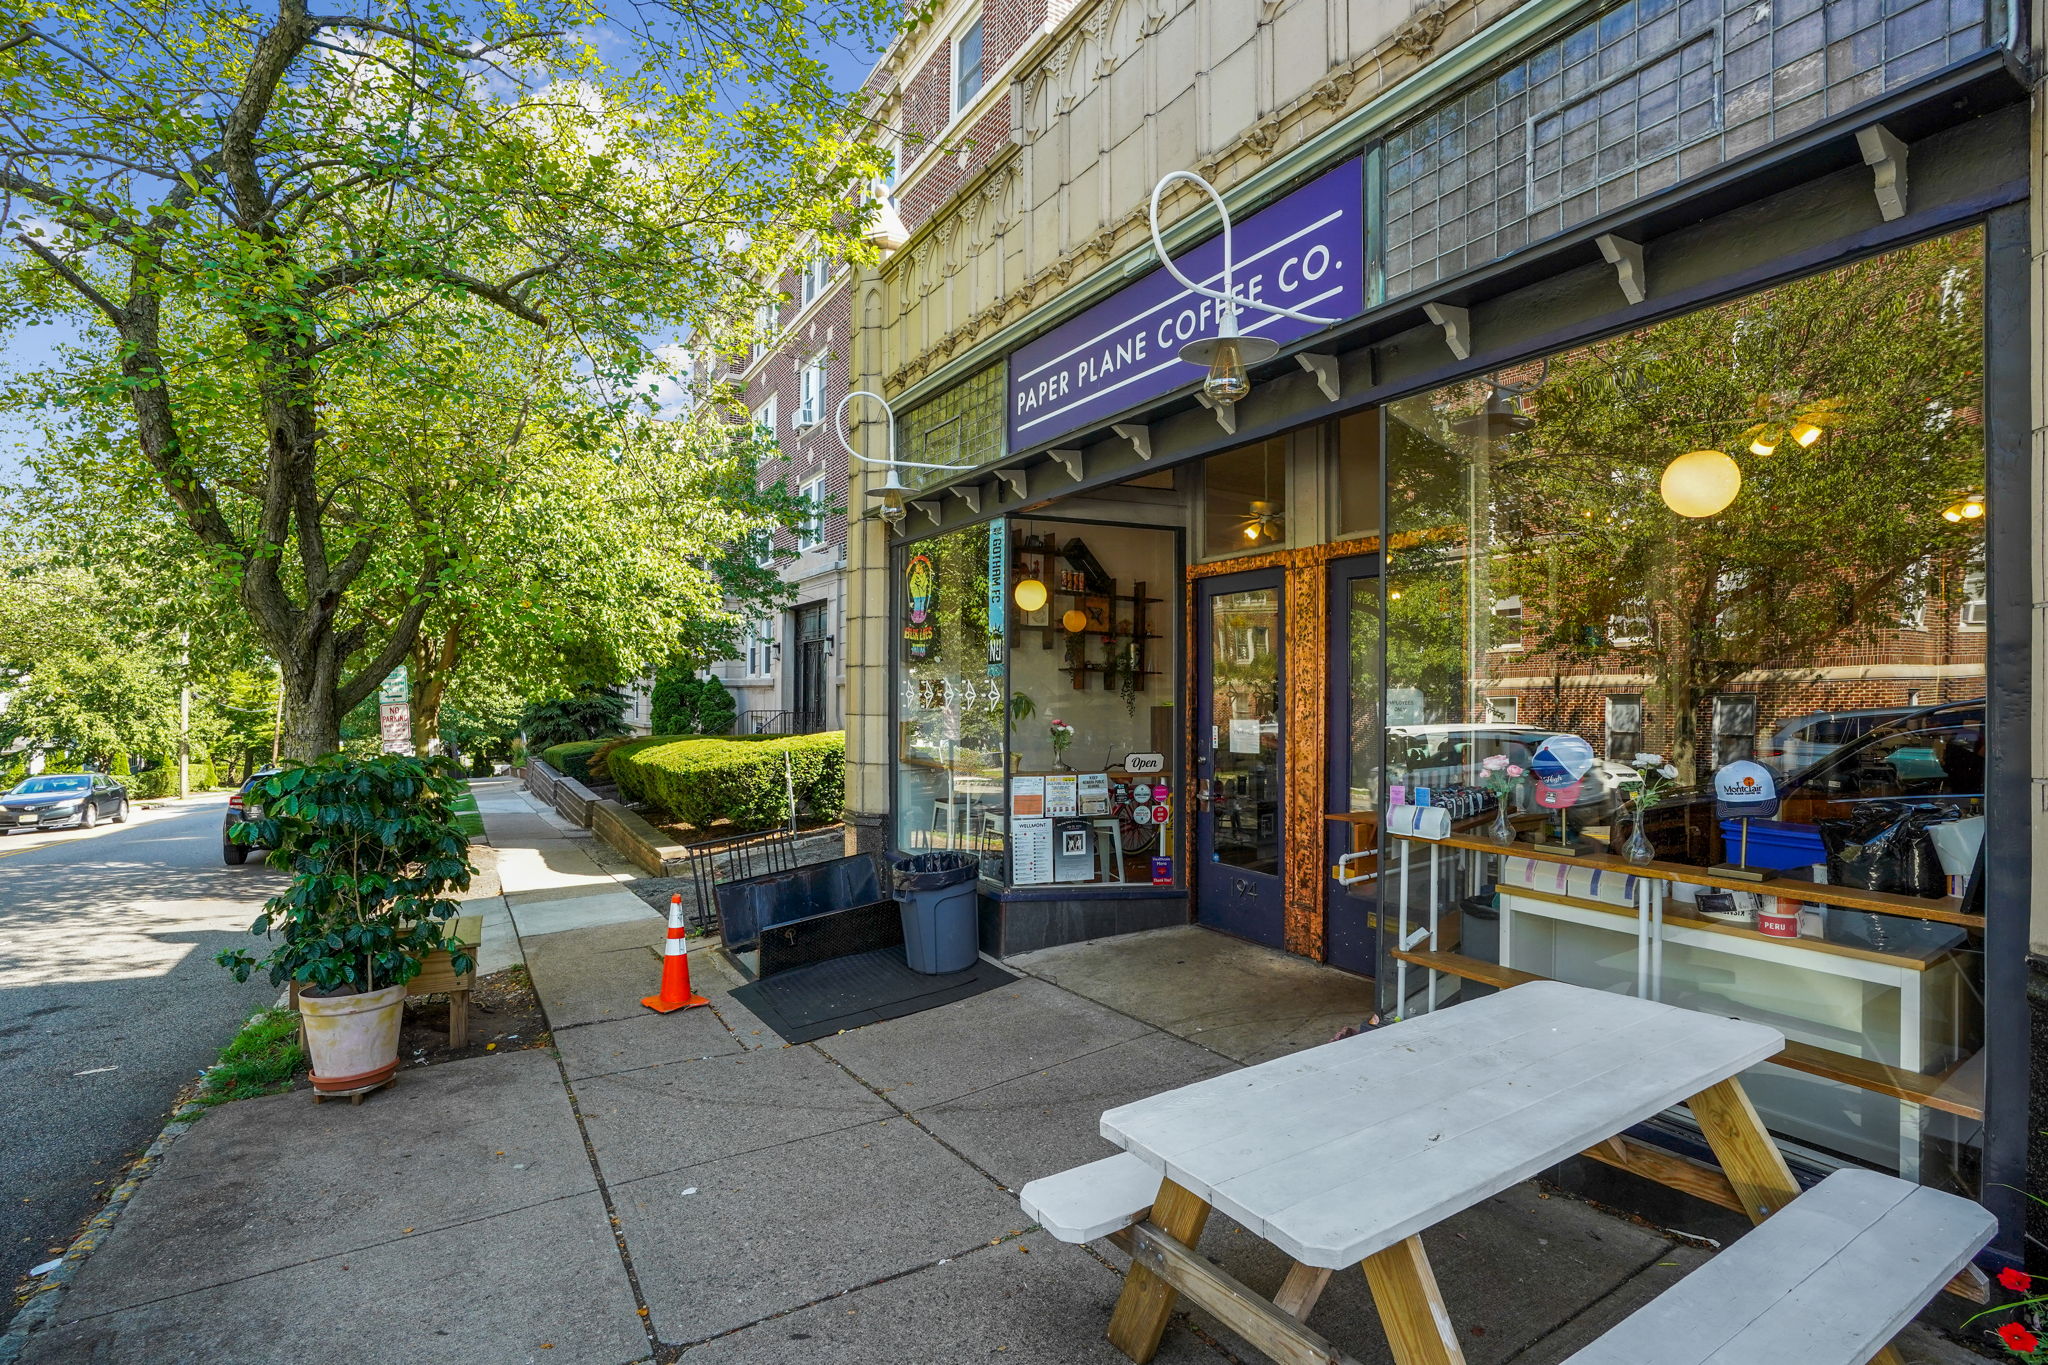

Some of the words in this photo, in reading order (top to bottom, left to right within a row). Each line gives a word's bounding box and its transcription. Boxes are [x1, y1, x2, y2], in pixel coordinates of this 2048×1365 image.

[1017, 371, 1069, 416] PAPER
[1079, 332, 1147, 387] PLANE
[1157, 274, 1263, 349] COFFEE
[1278, 245, 1343, 292] CO.
[992, 539, 1002, 586] GOTHAM
[991, 589, 1001, 604] FC
[383, 715, 408, 723] PARKING
[1131, 757, 1158, 771] Open
[1723, 783, 1763, 792] Montclair
[1230, 876, 1259, 903] 194
[1764, 921, 1786, 931] PERU
